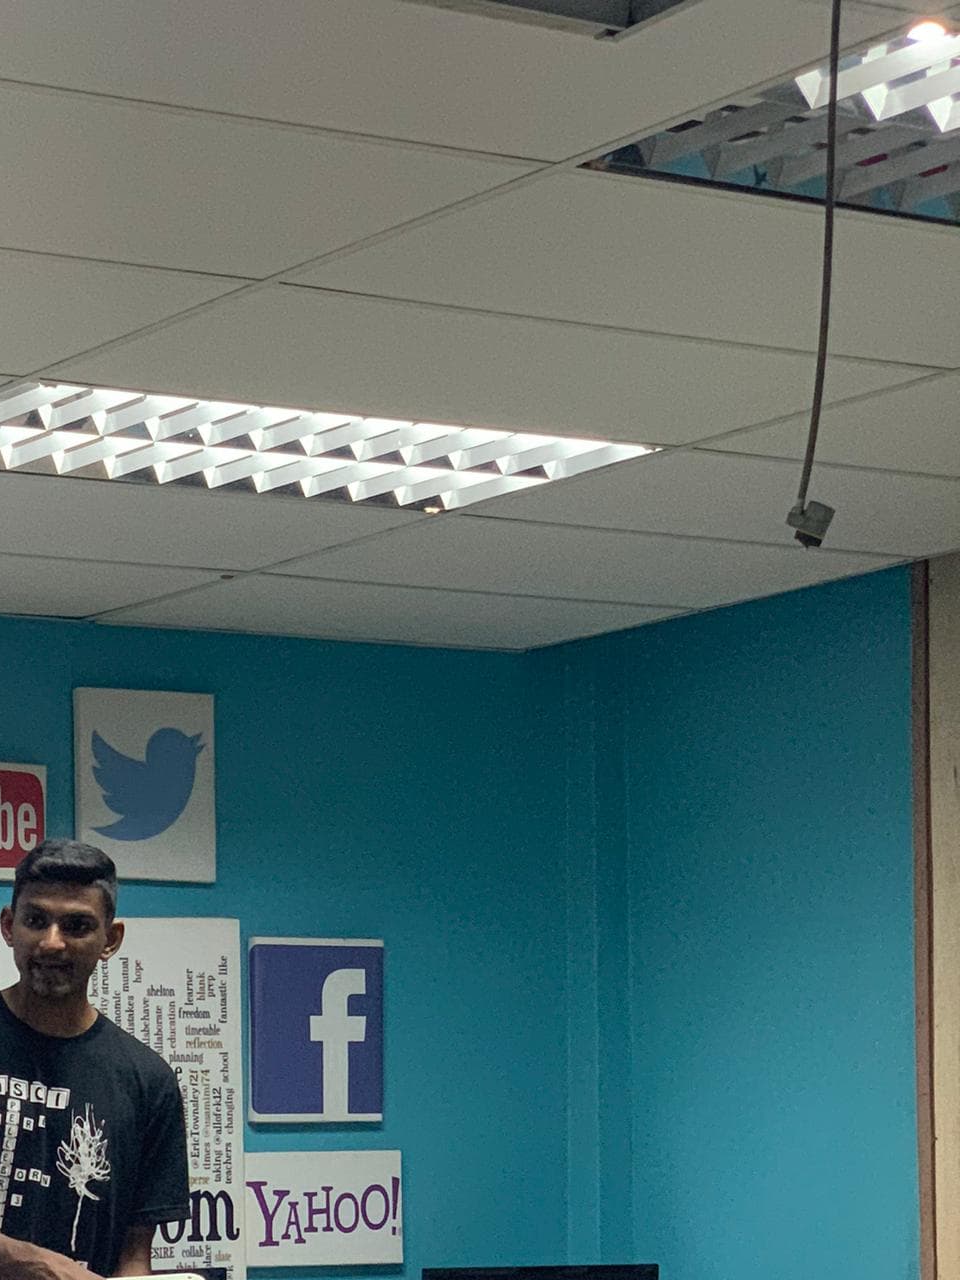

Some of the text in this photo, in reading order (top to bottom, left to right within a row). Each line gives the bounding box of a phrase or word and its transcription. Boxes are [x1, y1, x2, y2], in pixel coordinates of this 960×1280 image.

[120, 957, 129, 992] mutual
[133, 960, 144, 983] hope
[218, 955, 227, 975] like
[185, 969, 194, 1005] learner
[196, 972, 205, 1001] blank
[208, 975, 216, 998] prep
[178, 1007, 211, 1019] freedom
[218, 981, 227, 1024] fantastic
[167, 1001, 177, 1049] education
[185, 1024, 221, 1036] timetable
[186, 1039, 223, 1049] reflection
[169, 1053, 204, 1065] planning
[220, 1052, 229, 1083] school
[224, 1088, 235, 1135] changing
[202, 1142, 211, 1170] times
[212, 1150, 223, 1182] taking
[224, 1142, 233, 1184] teachers
